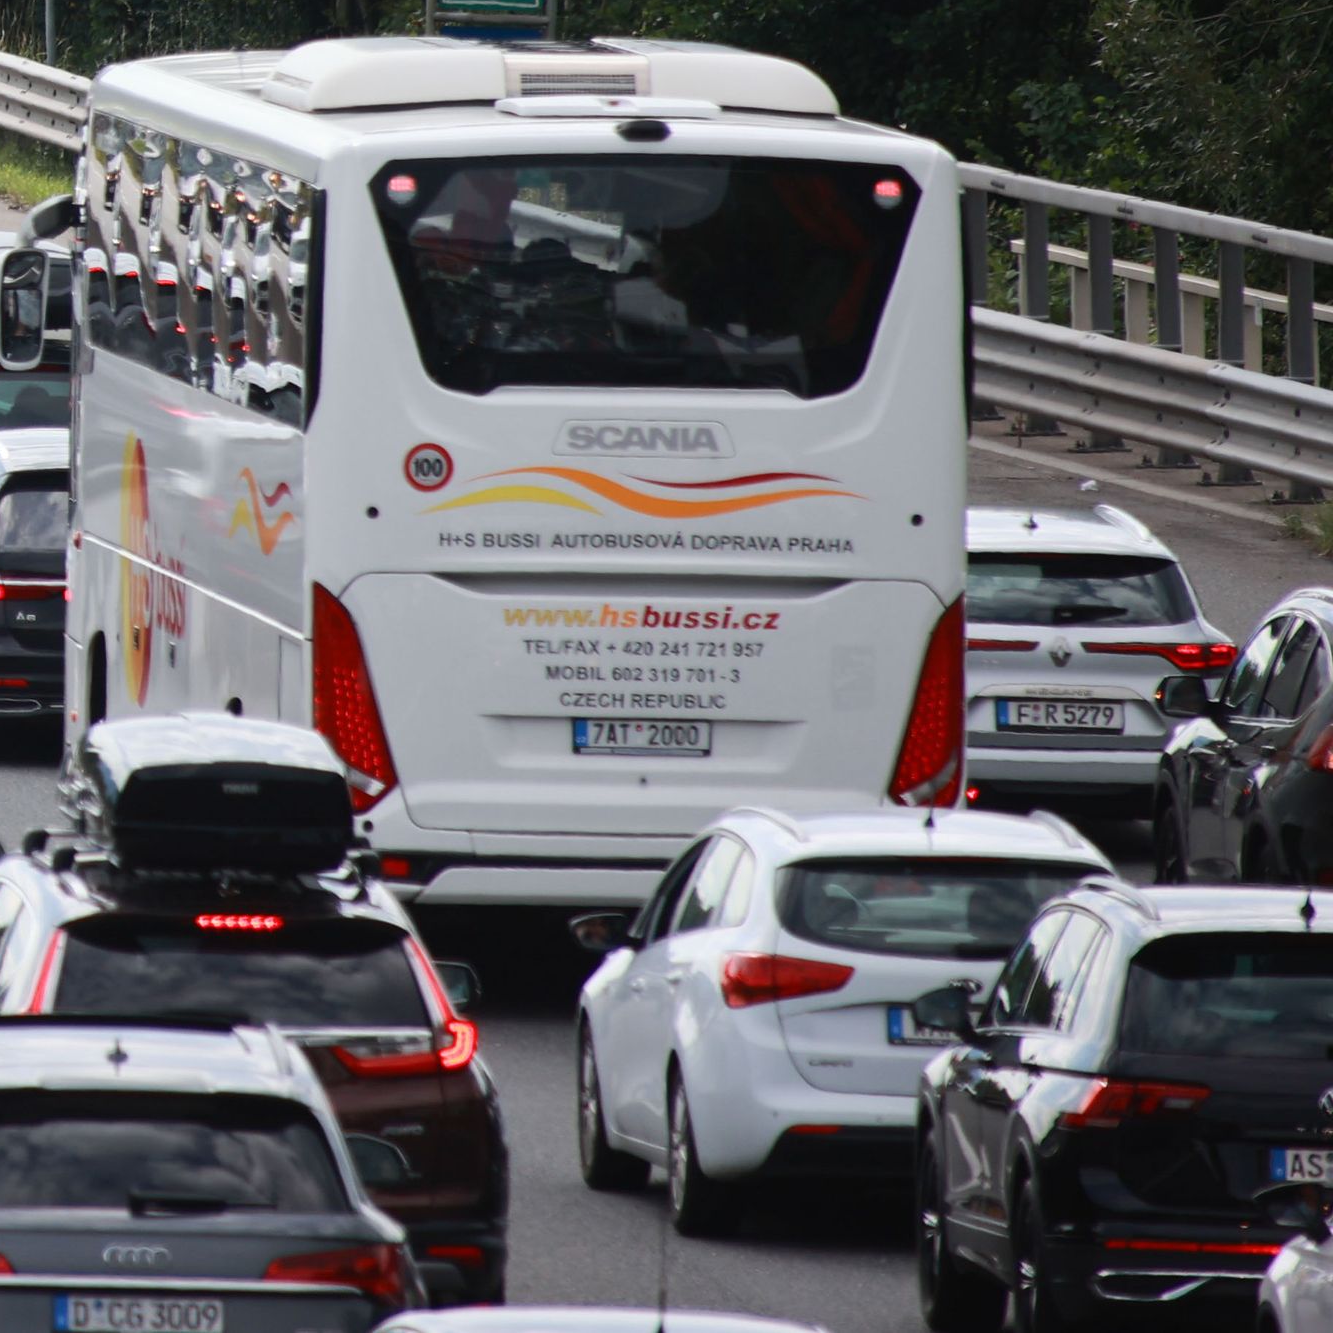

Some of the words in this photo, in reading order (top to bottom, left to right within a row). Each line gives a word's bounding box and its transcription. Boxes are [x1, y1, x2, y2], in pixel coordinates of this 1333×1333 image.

[566, 426, 719, 452] SCANIA
[413, 457, 443, 477] 100
[439, 533, 476, 548] H+S
[483, 533, 541, 548] BUSSI
[551, 531, 684, 549] AUTOBUSOVÁ
[691, 534, 782, 551] DOPRAVA
[788, 537, 854, 553] PRAHA
[503, 604, 781, 630] www.hsbussi.cz
[523, 639, 600, 655] TEL/FAX
[606, 643, 616, 653] +
[623, 640, 654, 656] 420
[660, 640, 689, 656] 241
[697, 642, 726, 657] 721
[733, 642, 764, 657] 957
[545, 665, 605, 681] MOBIL
[612, 666, 643, 682] 602
[649, 666, 680, 682] 319
[559, 692, 624, 708] CZECH
[631, 693, 726, 709] REPUBLIC
[1017, 704, 1029, 723] F
[1045, 704, 1058, 724] R
[1064, 705, 1114, 726] 5279
[593, 724, 630, 745] 7AT
[649, 725, 699, 746] 2000
[1290, 1153, 1324, 1178] AS
[74, 1301, 88, 1328] D
[108, 1302, 143, 1328] CG
[149, 1303, 218, 1330] 3009
